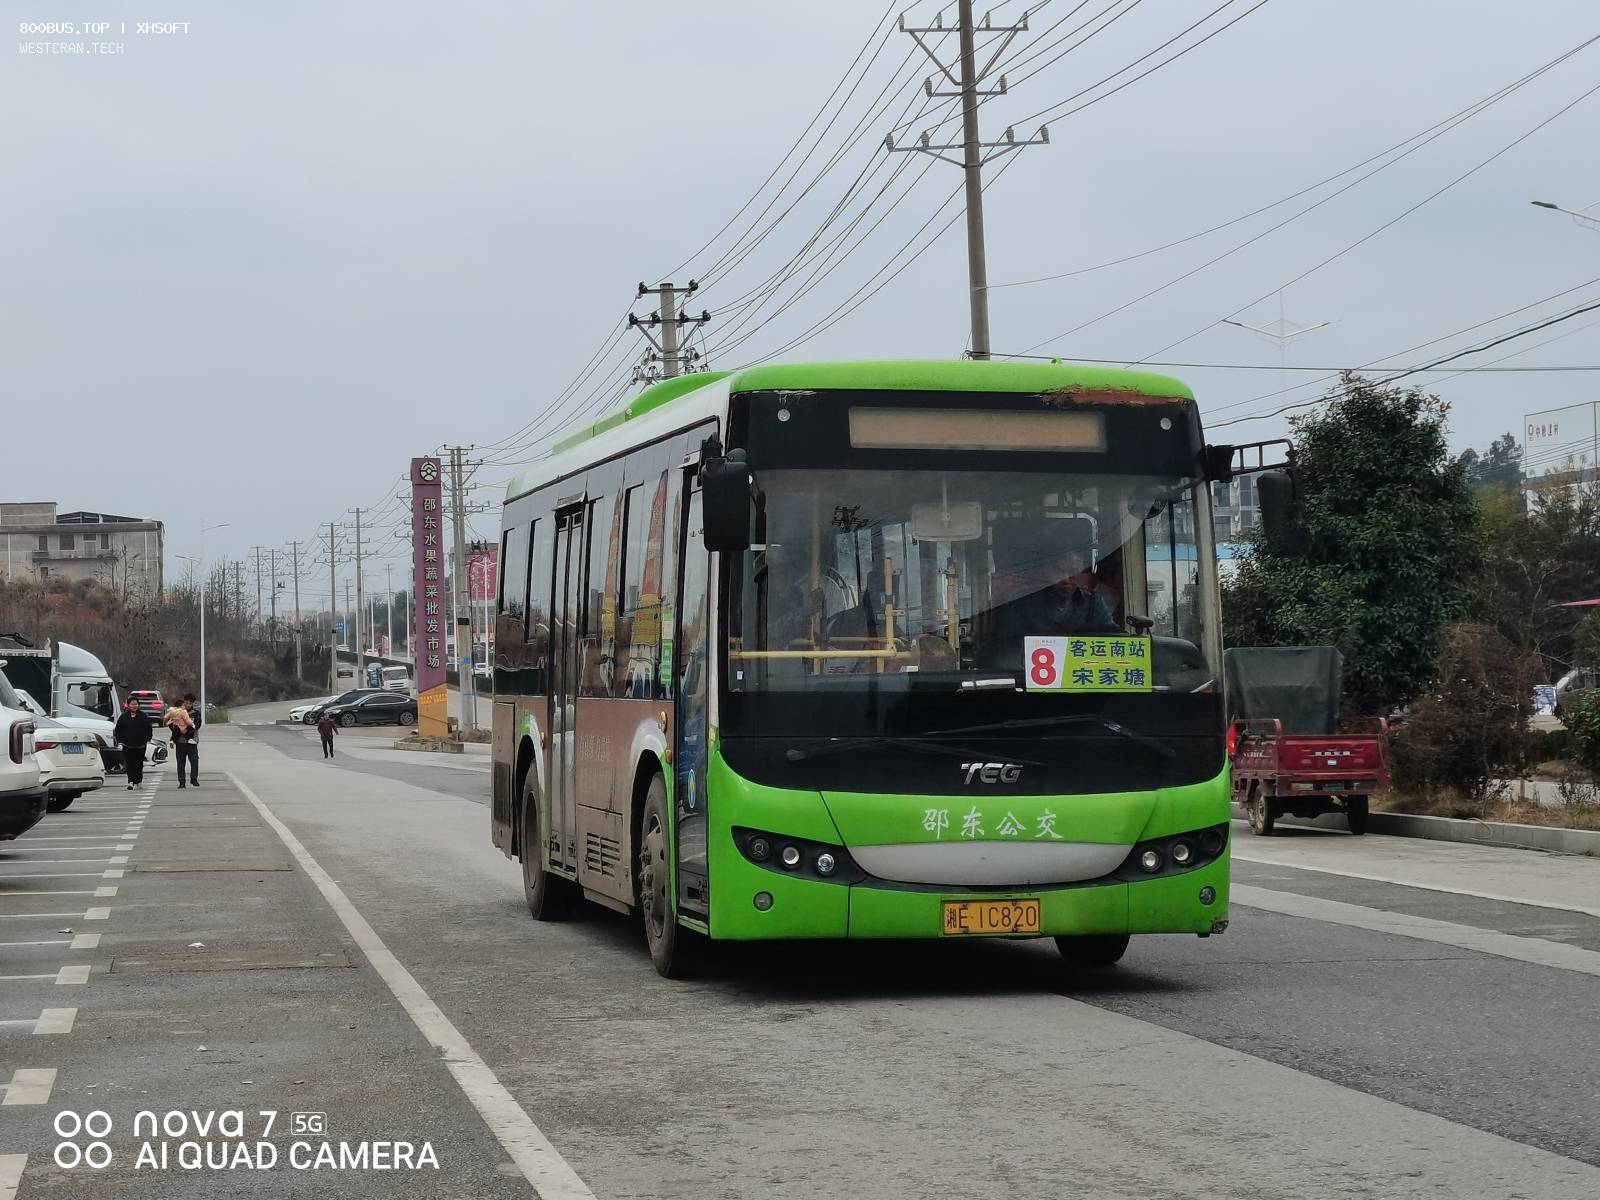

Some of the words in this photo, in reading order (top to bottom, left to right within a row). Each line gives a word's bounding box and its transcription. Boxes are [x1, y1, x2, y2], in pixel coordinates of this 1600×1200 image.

[423, 498, 440, 668] 邵东水果蔬菜批发市场
[1070, 640, 1145, 657] 客运南站
[1031, 647, 1057, 685] 8
[1072, 667, 1145, 686] 宋家塘
[961, 762, 1023, 785] TEG
[921, 805, 1064, 839] 邵东公交
